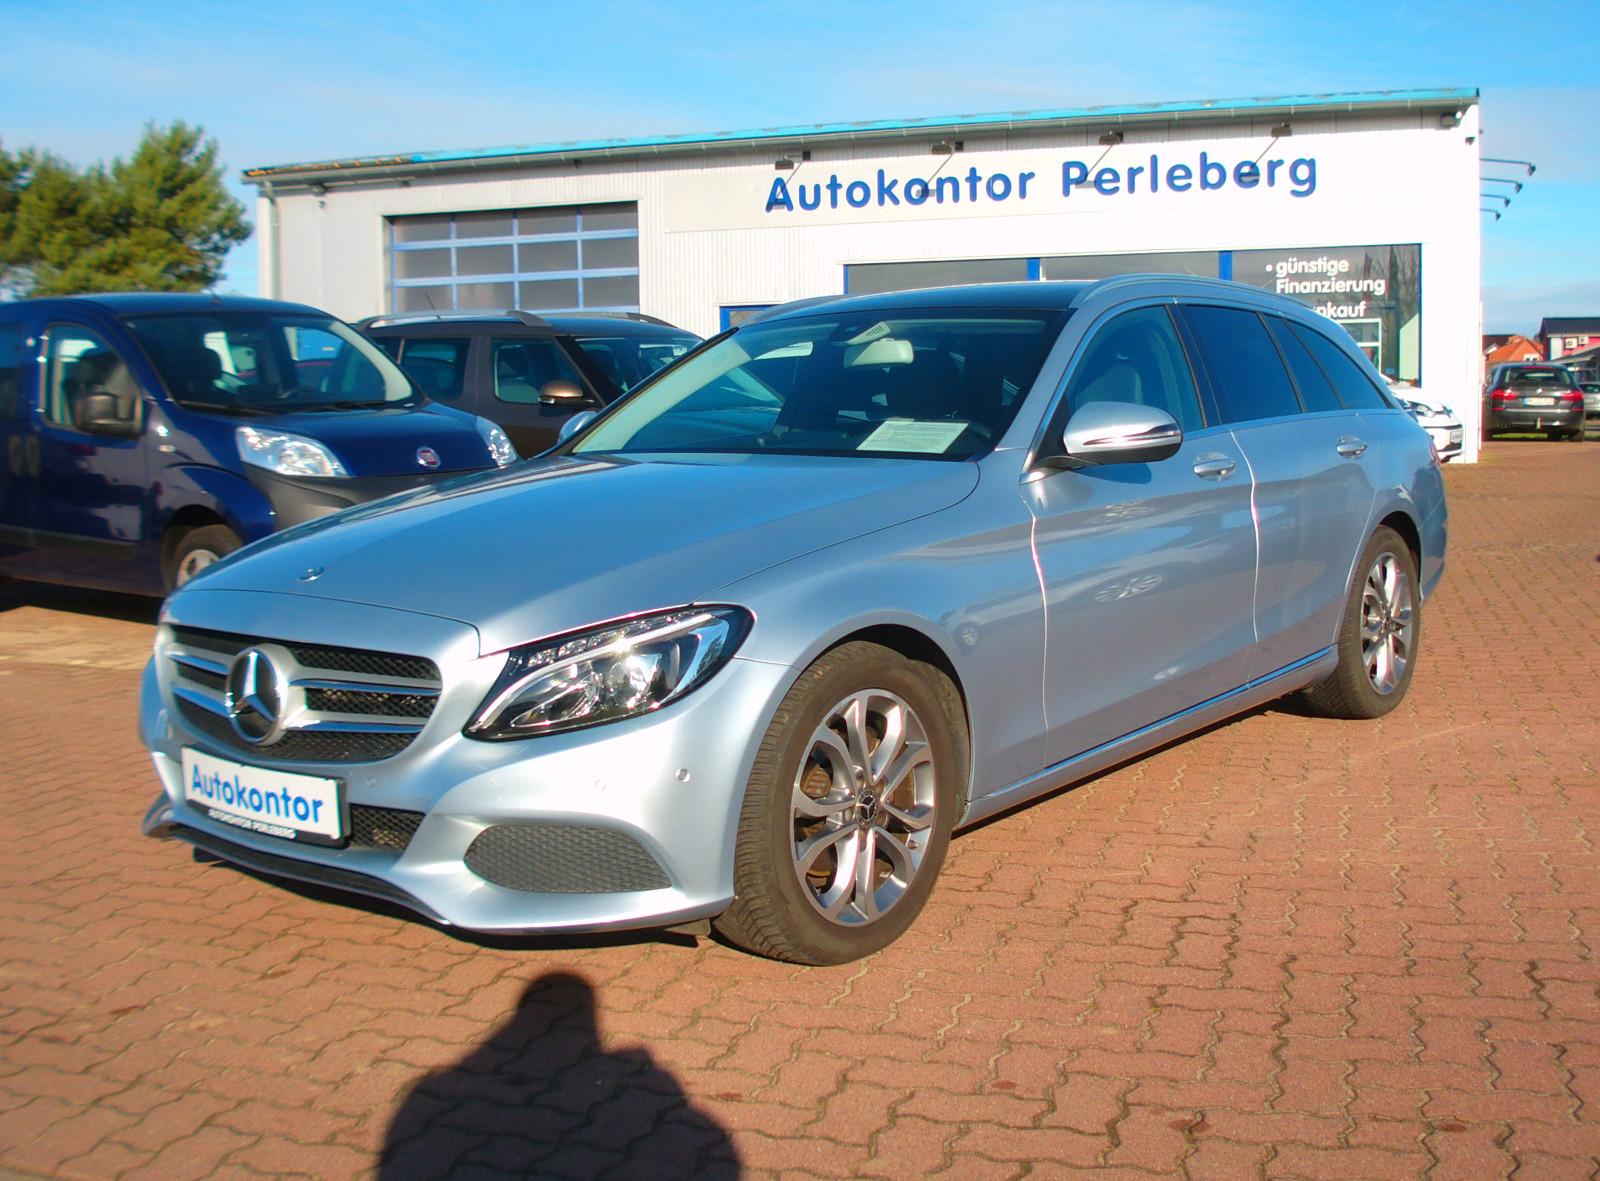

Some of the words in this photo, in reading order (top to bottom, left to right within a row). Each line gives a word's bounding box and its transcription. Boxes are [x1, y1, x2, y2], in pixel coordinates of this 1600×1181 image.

[765, 167, 1036, 212] Autokontor
[1062, 151, 1317, 198] Perleberg
[1276, 256, 1349, 278] günstige
[1276, 276, 1386, 296] Finanzierung
[1313, 301, 1367, 318] nkauf
[191, 763, 324, 825] Autokontor
